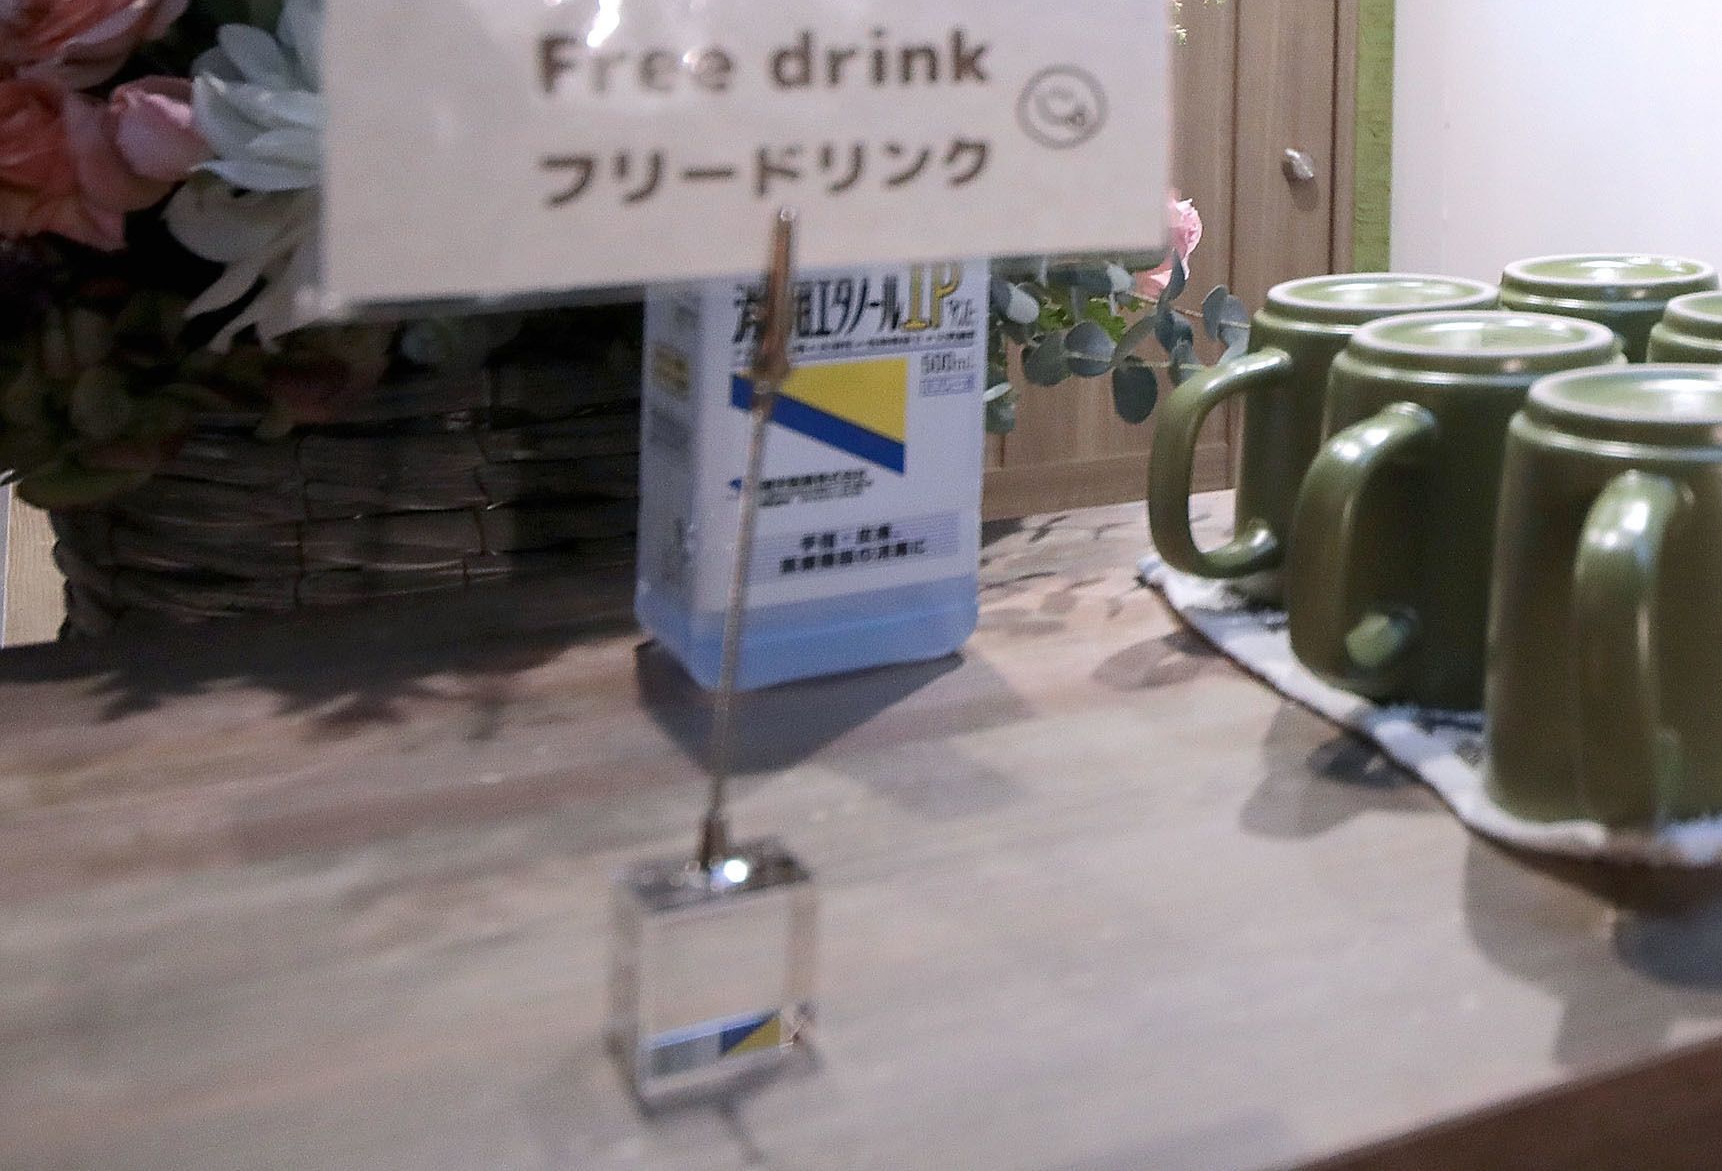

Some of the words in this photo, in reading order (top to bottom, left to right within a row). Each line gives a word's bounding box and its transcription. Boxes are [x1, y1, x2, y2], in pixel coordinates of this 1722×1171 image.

[536, 31, 734, 95] Free
[767, 27, 990, 90] drink
[538, 137, 991, 209] フリードリンク
